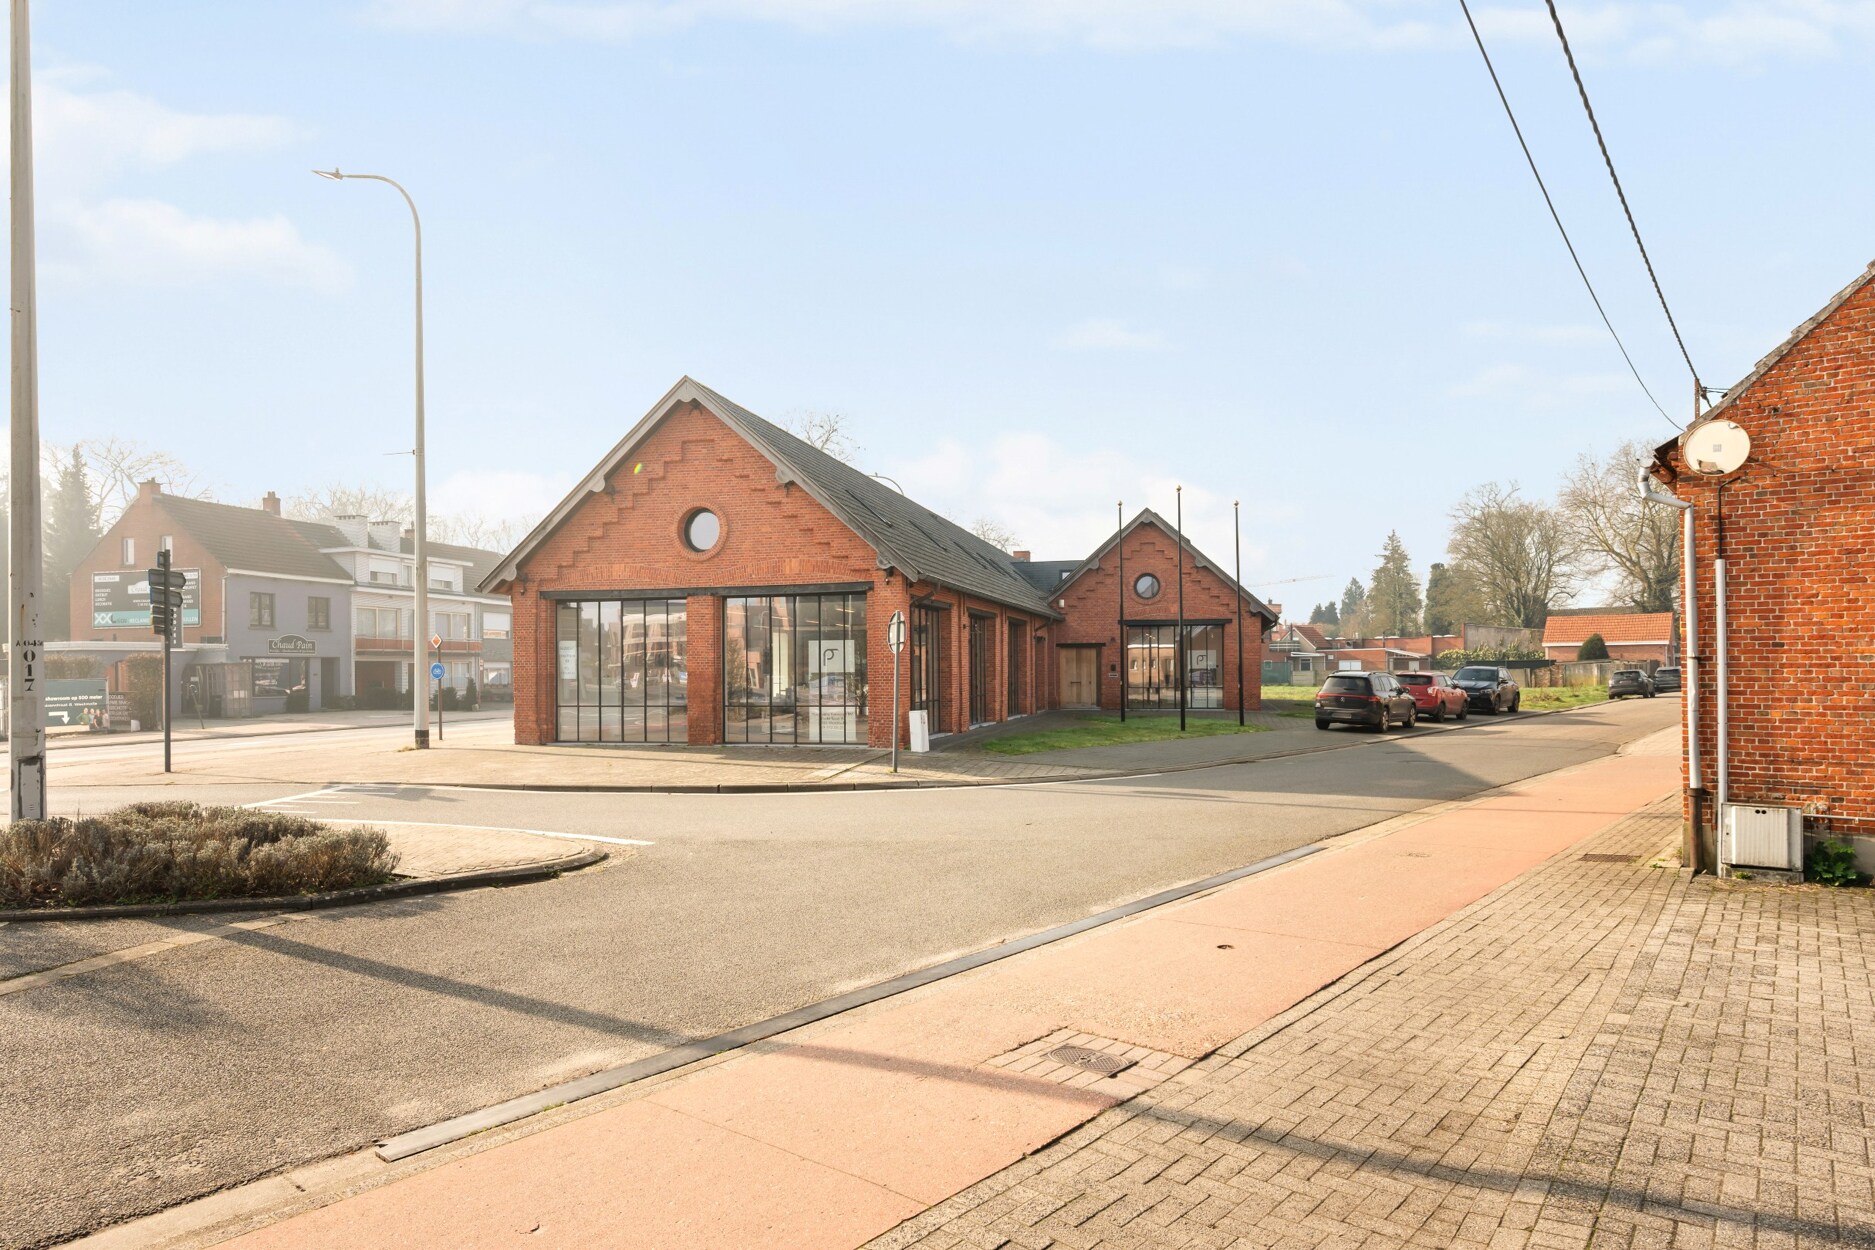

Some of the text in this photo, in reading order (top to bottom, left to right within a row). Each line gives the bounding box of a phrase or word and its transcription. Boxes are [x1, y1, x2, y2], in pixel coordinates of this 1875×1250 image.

[271, 639, 313, 649] Chaud Pain
[23, 649, 36, 692] 017
